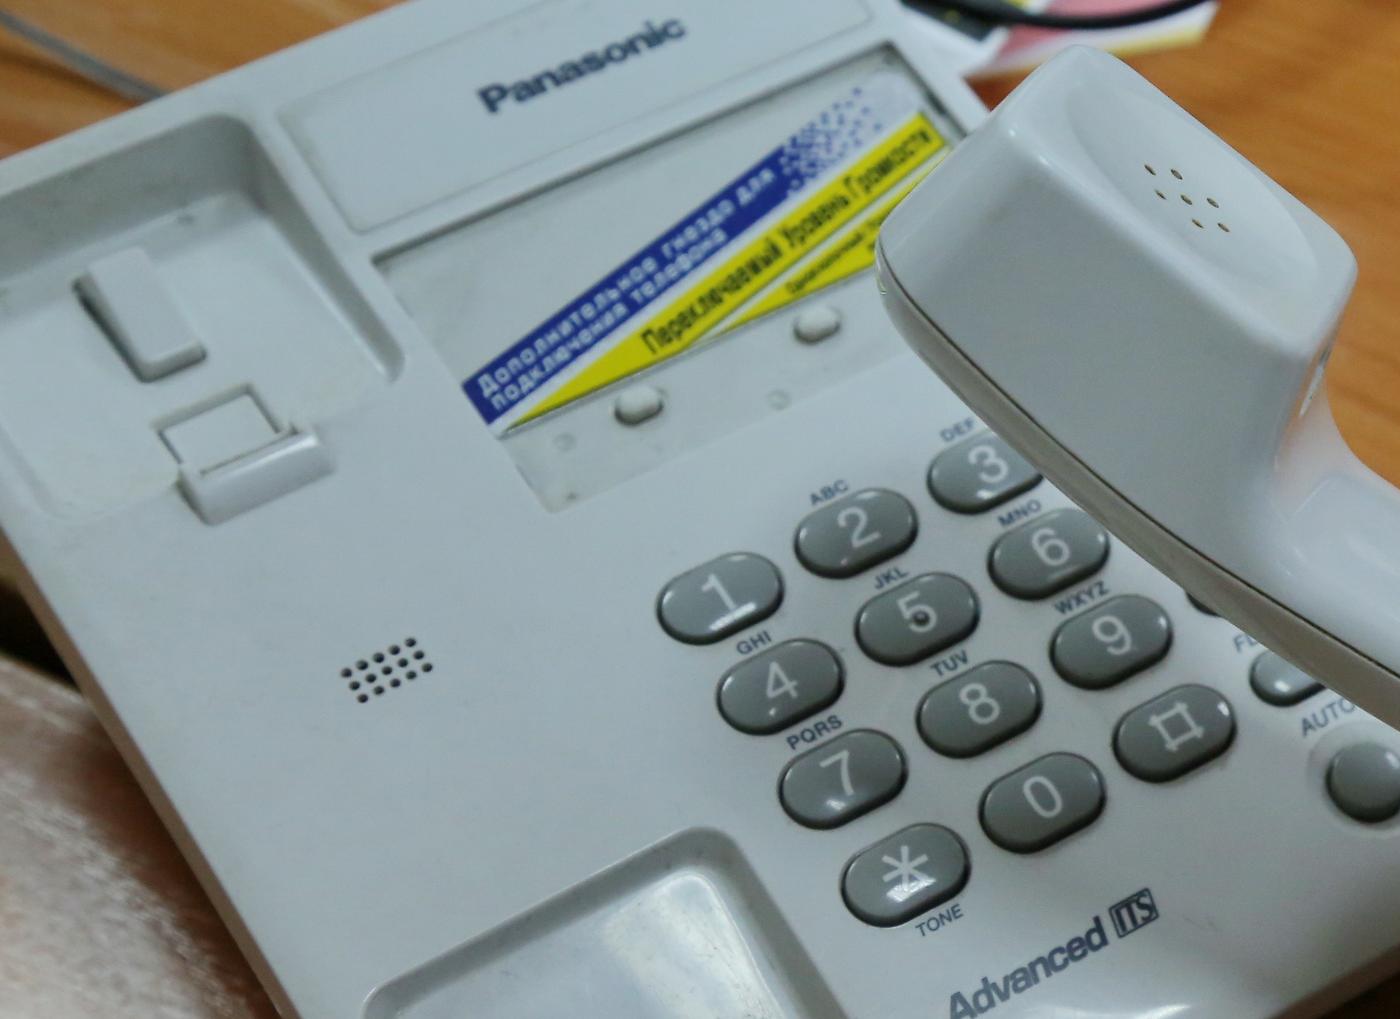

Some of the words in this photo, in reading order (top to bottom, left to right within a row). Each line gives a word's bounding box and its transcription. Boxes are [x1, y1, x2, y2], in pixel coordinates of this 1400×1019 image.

[477, 19, 687, 114] Panasonic
[641, 237, 782, 354] Переключаемый
[777, 195, 848, 249] Уровень
[843, 129, 931, 199] Громкости
[477, 256, 658, 398] Дополнительное
[661, 199, 734, 259] гнездо
[736, 167, 774, 207] для
[491, 303, 628, 411] подключения
[629, 227, 727, 303] телефона
[940, 416, 975, 442] DEF
[968, 445, 1008, 483] 3
[810, 479, 849, 506] ABC
[838, 506, 881, 549] 2
[998, 500, 1041, 526] MNO
[1031, 528, 1070, 567] 6
[701, 573, 741, 614] 1
[873, 568, 909, 590] JKL
[1054, 580, 1109, 614] WXYZ
[897, 590, 937, 633] 5
[735, 631, 773, 655] GHI
[1092, 615, 1132, 655] 9
[766, 661, 798, 699] 4
[930, 650, 969, 677] TUV
[959, 682, 1000, 725] 8
[786, 714, 843, 751] PQRS
[819, 749, 855, 796] 7
[1023, 775, 1062, 818] 0
[915, 904, 963, 937] TONE
[949, 917, 1110, 1019] Advanced
[1112, 887, 1157, 936] ITS
